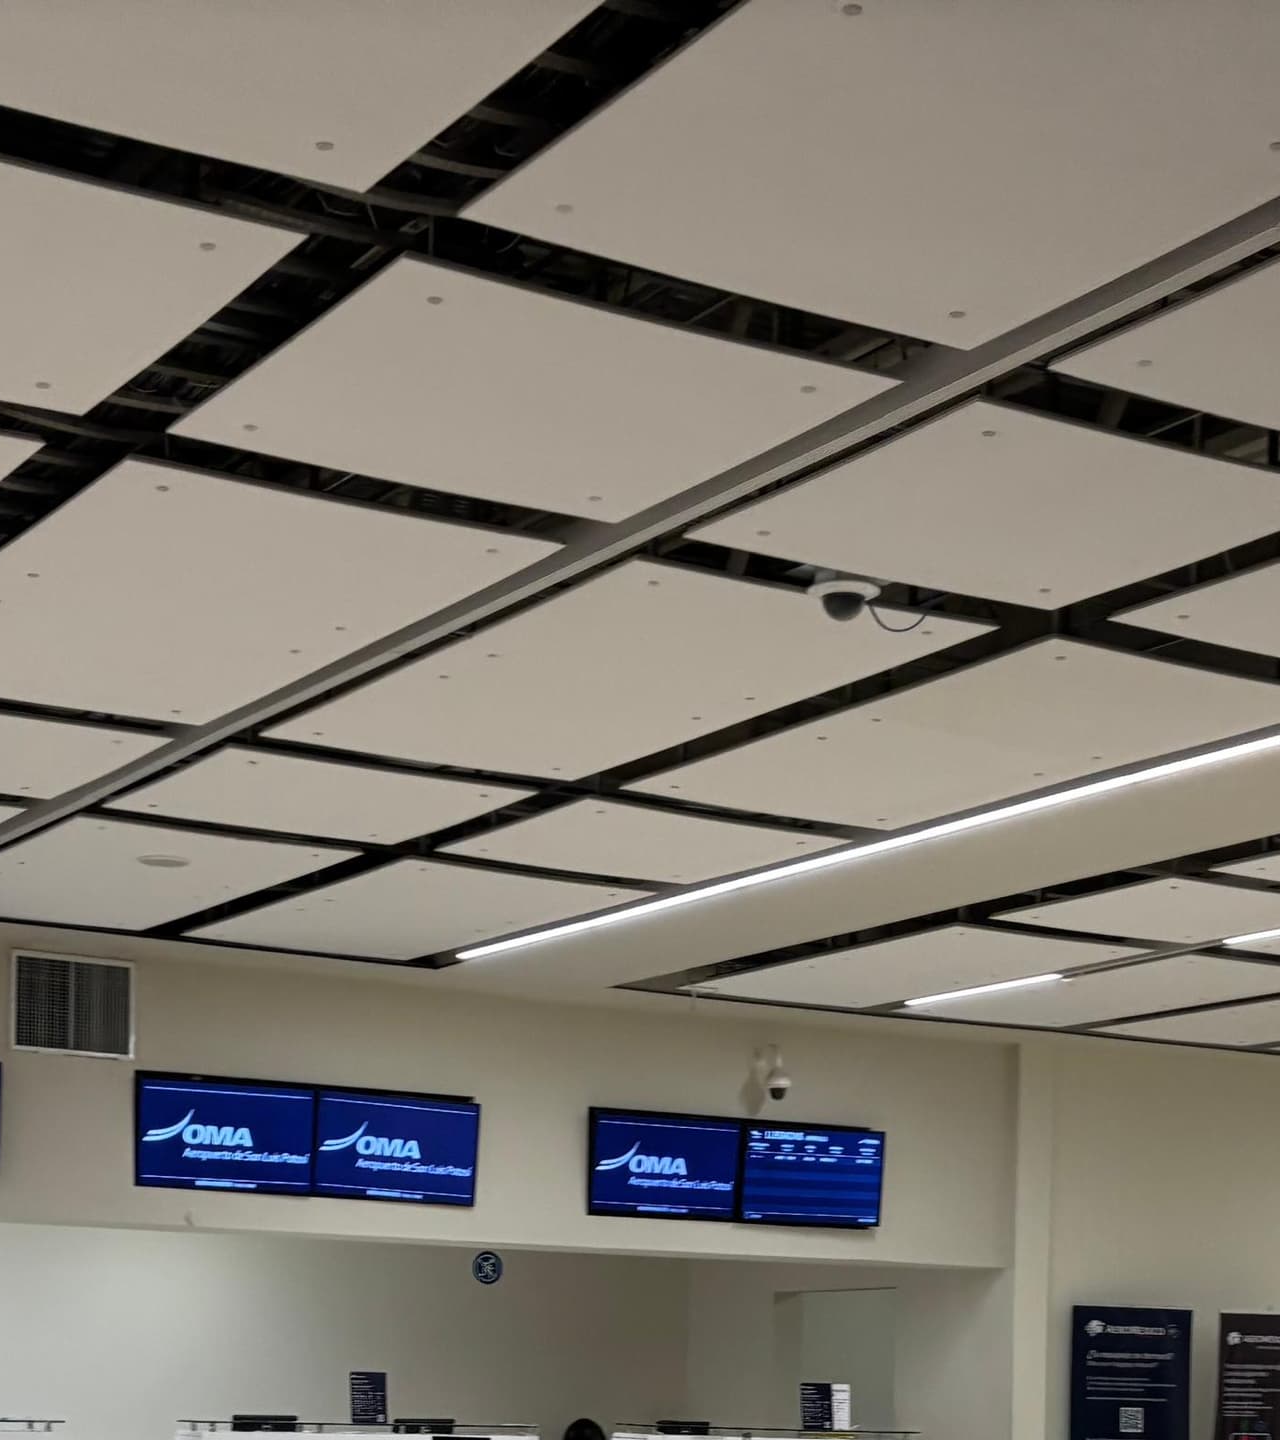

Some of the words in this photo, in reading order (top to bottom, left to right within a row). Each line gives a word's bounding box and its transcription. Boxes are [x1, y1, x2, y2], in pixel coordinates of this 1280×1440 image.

[182, 1124, 253, 1147] OMA
[356, 1135, 421, 1159] OMA
[628, 1154, 688, 1176] OMA
